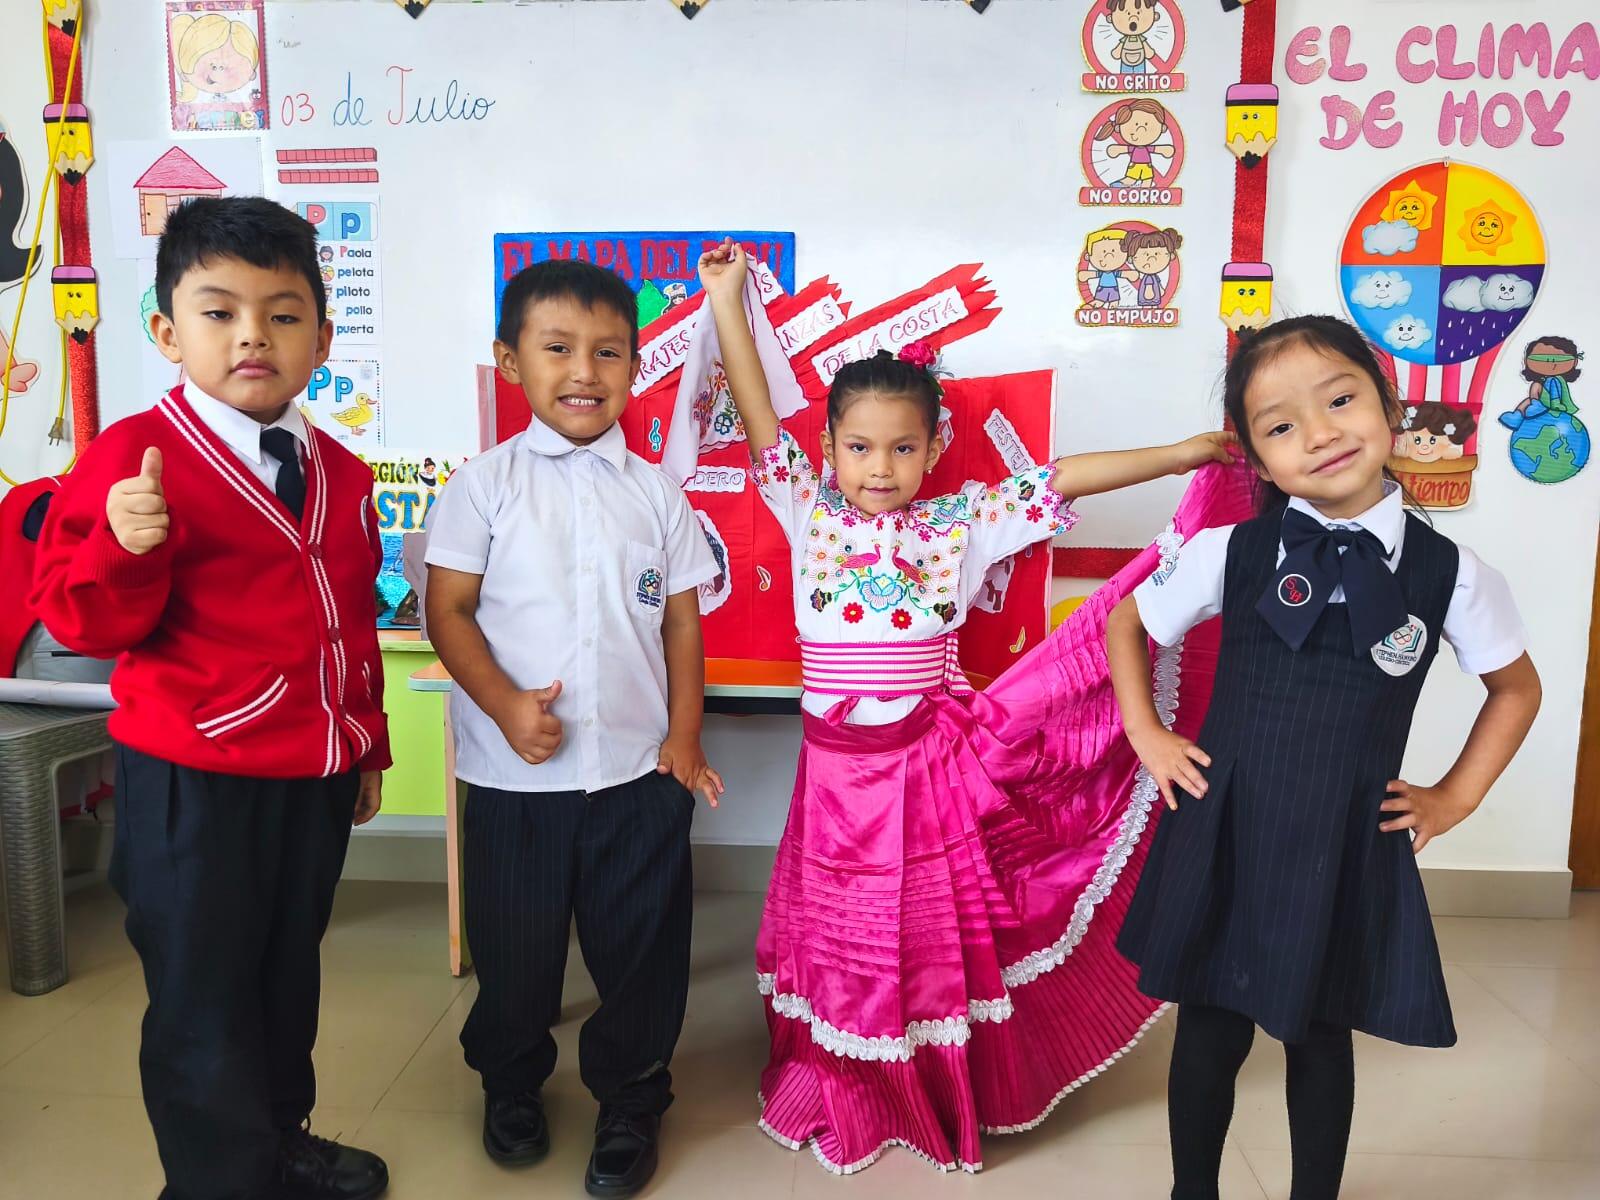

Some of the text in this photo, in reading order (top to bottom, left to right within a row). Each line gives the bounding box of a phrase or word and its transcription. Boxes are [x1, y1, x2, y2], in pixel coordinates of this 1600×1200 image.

[1285, 21, 1600, 84] EL CLIMA
[281, 65, 497, 127] 03 de Julio
[1095, 75, 1171, 90] NO GRITO
[1319, 89, 1571, 150] DE HOY
[1089, 188, 1172, 204] NO CORRO
[339, 245, 372, 258] Paola
[640, 240, 697, 280] DEL
[337, 266, 374, 279] pelota
[336, 285, 371, 299] piloto
[345, 305, 373, 317] pollo
[889, 297, 958, 345] COSTA
[1078, 309, 1175, 325] NO EMPUJO
[336, 324, 374, 336] puerta
[781, 303, 834, 351] NZAS
[634, 329, 691, 386] RAJES
[987, 414, 1031, 474] FESTEJ
[367, 456, 420, 484] EGIÓN
[693, 470, 744, 486] DERO
[1408, 473, 1470, 507] tiempo
